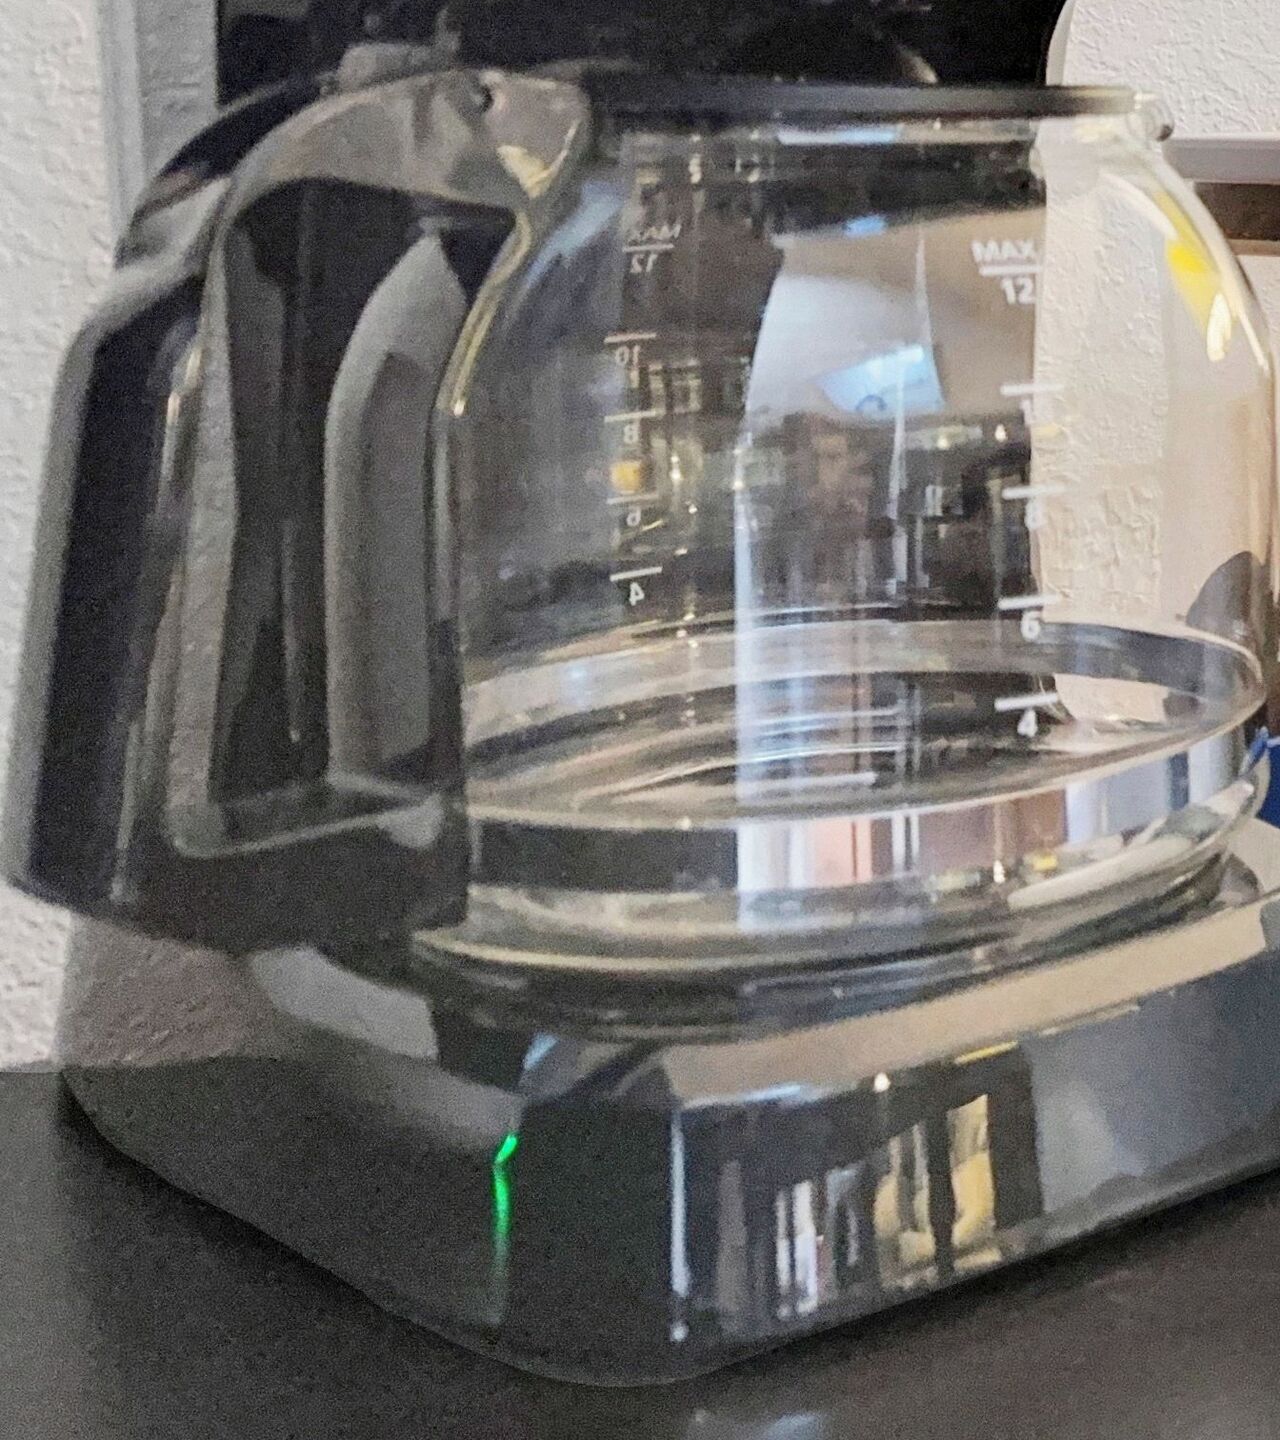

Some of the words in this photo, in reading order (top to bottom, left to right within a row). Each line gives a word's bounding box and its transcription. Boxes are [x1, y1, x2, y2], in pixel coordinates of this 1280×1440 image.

[971, 240, 1036, 263] MAX
[1001, 276, 1036, 305] 12
[1021, 610, 1042, 642] 6
